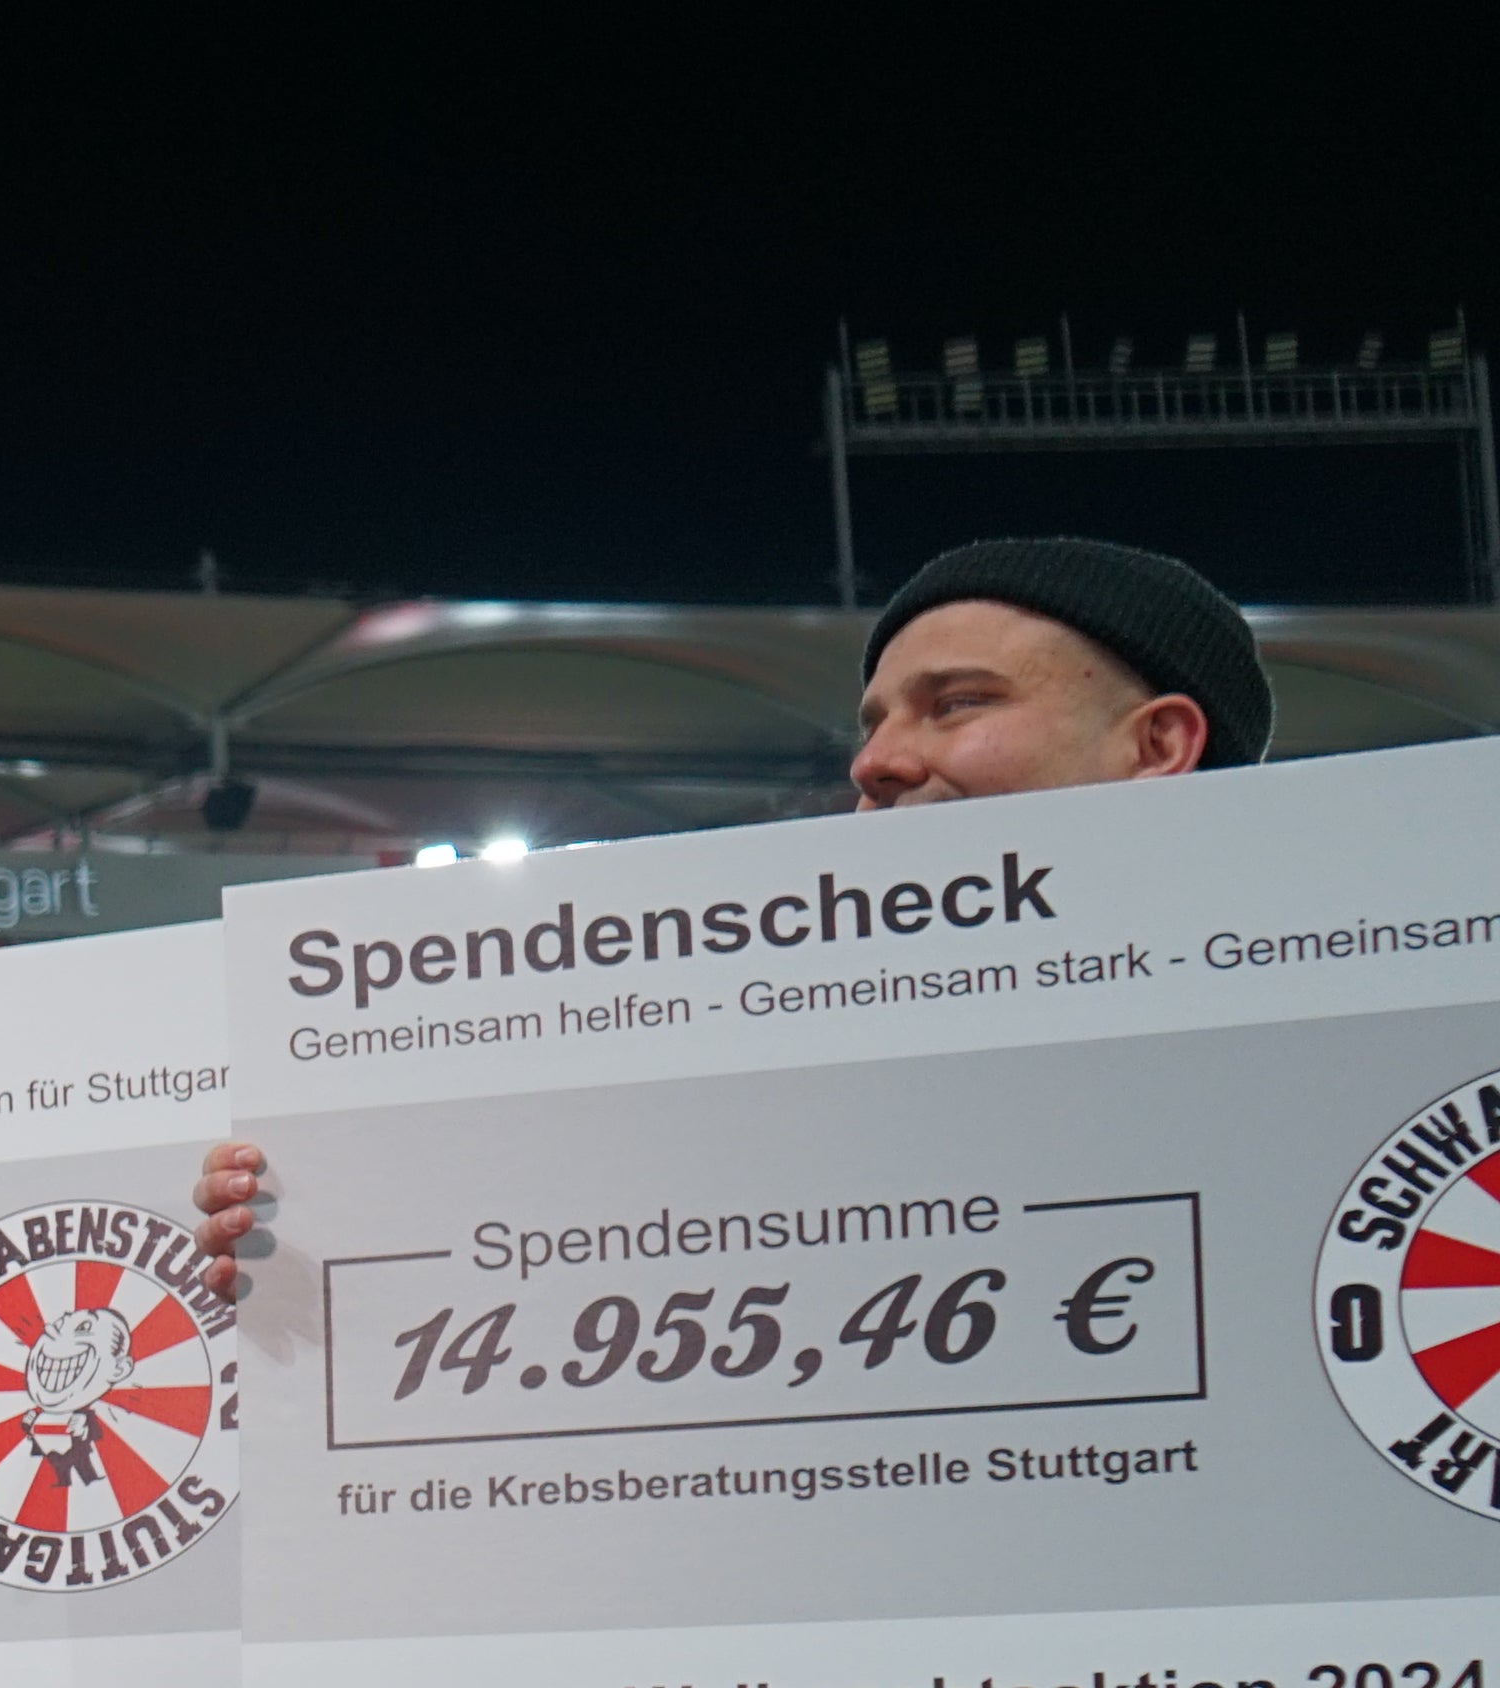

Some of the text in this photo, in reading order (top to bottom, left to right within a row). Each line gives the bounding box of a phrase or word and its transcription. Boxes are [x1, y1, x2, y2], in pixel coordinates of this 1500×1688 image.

[288, 852, 1057, 1008] Spendenscheck
[289, 1006, 543, 1061] Gemeinsam
[559, 992, 691, 1036] helfen
[740, 959, 1018, 1016] Gemeinsam
[1036, 942, 1153, 988] stark
[27, 1079, 74, 1111] für
[87, 1062, 231, 1104] Stuttgar
[471, 1194, 1002, 1280] Spendensumme
[390, 1255, 1156, 1403] 14.955,46 €
[337, 1438, 1200, 1518] für die Krebsberatungsstelle Stuttgart
